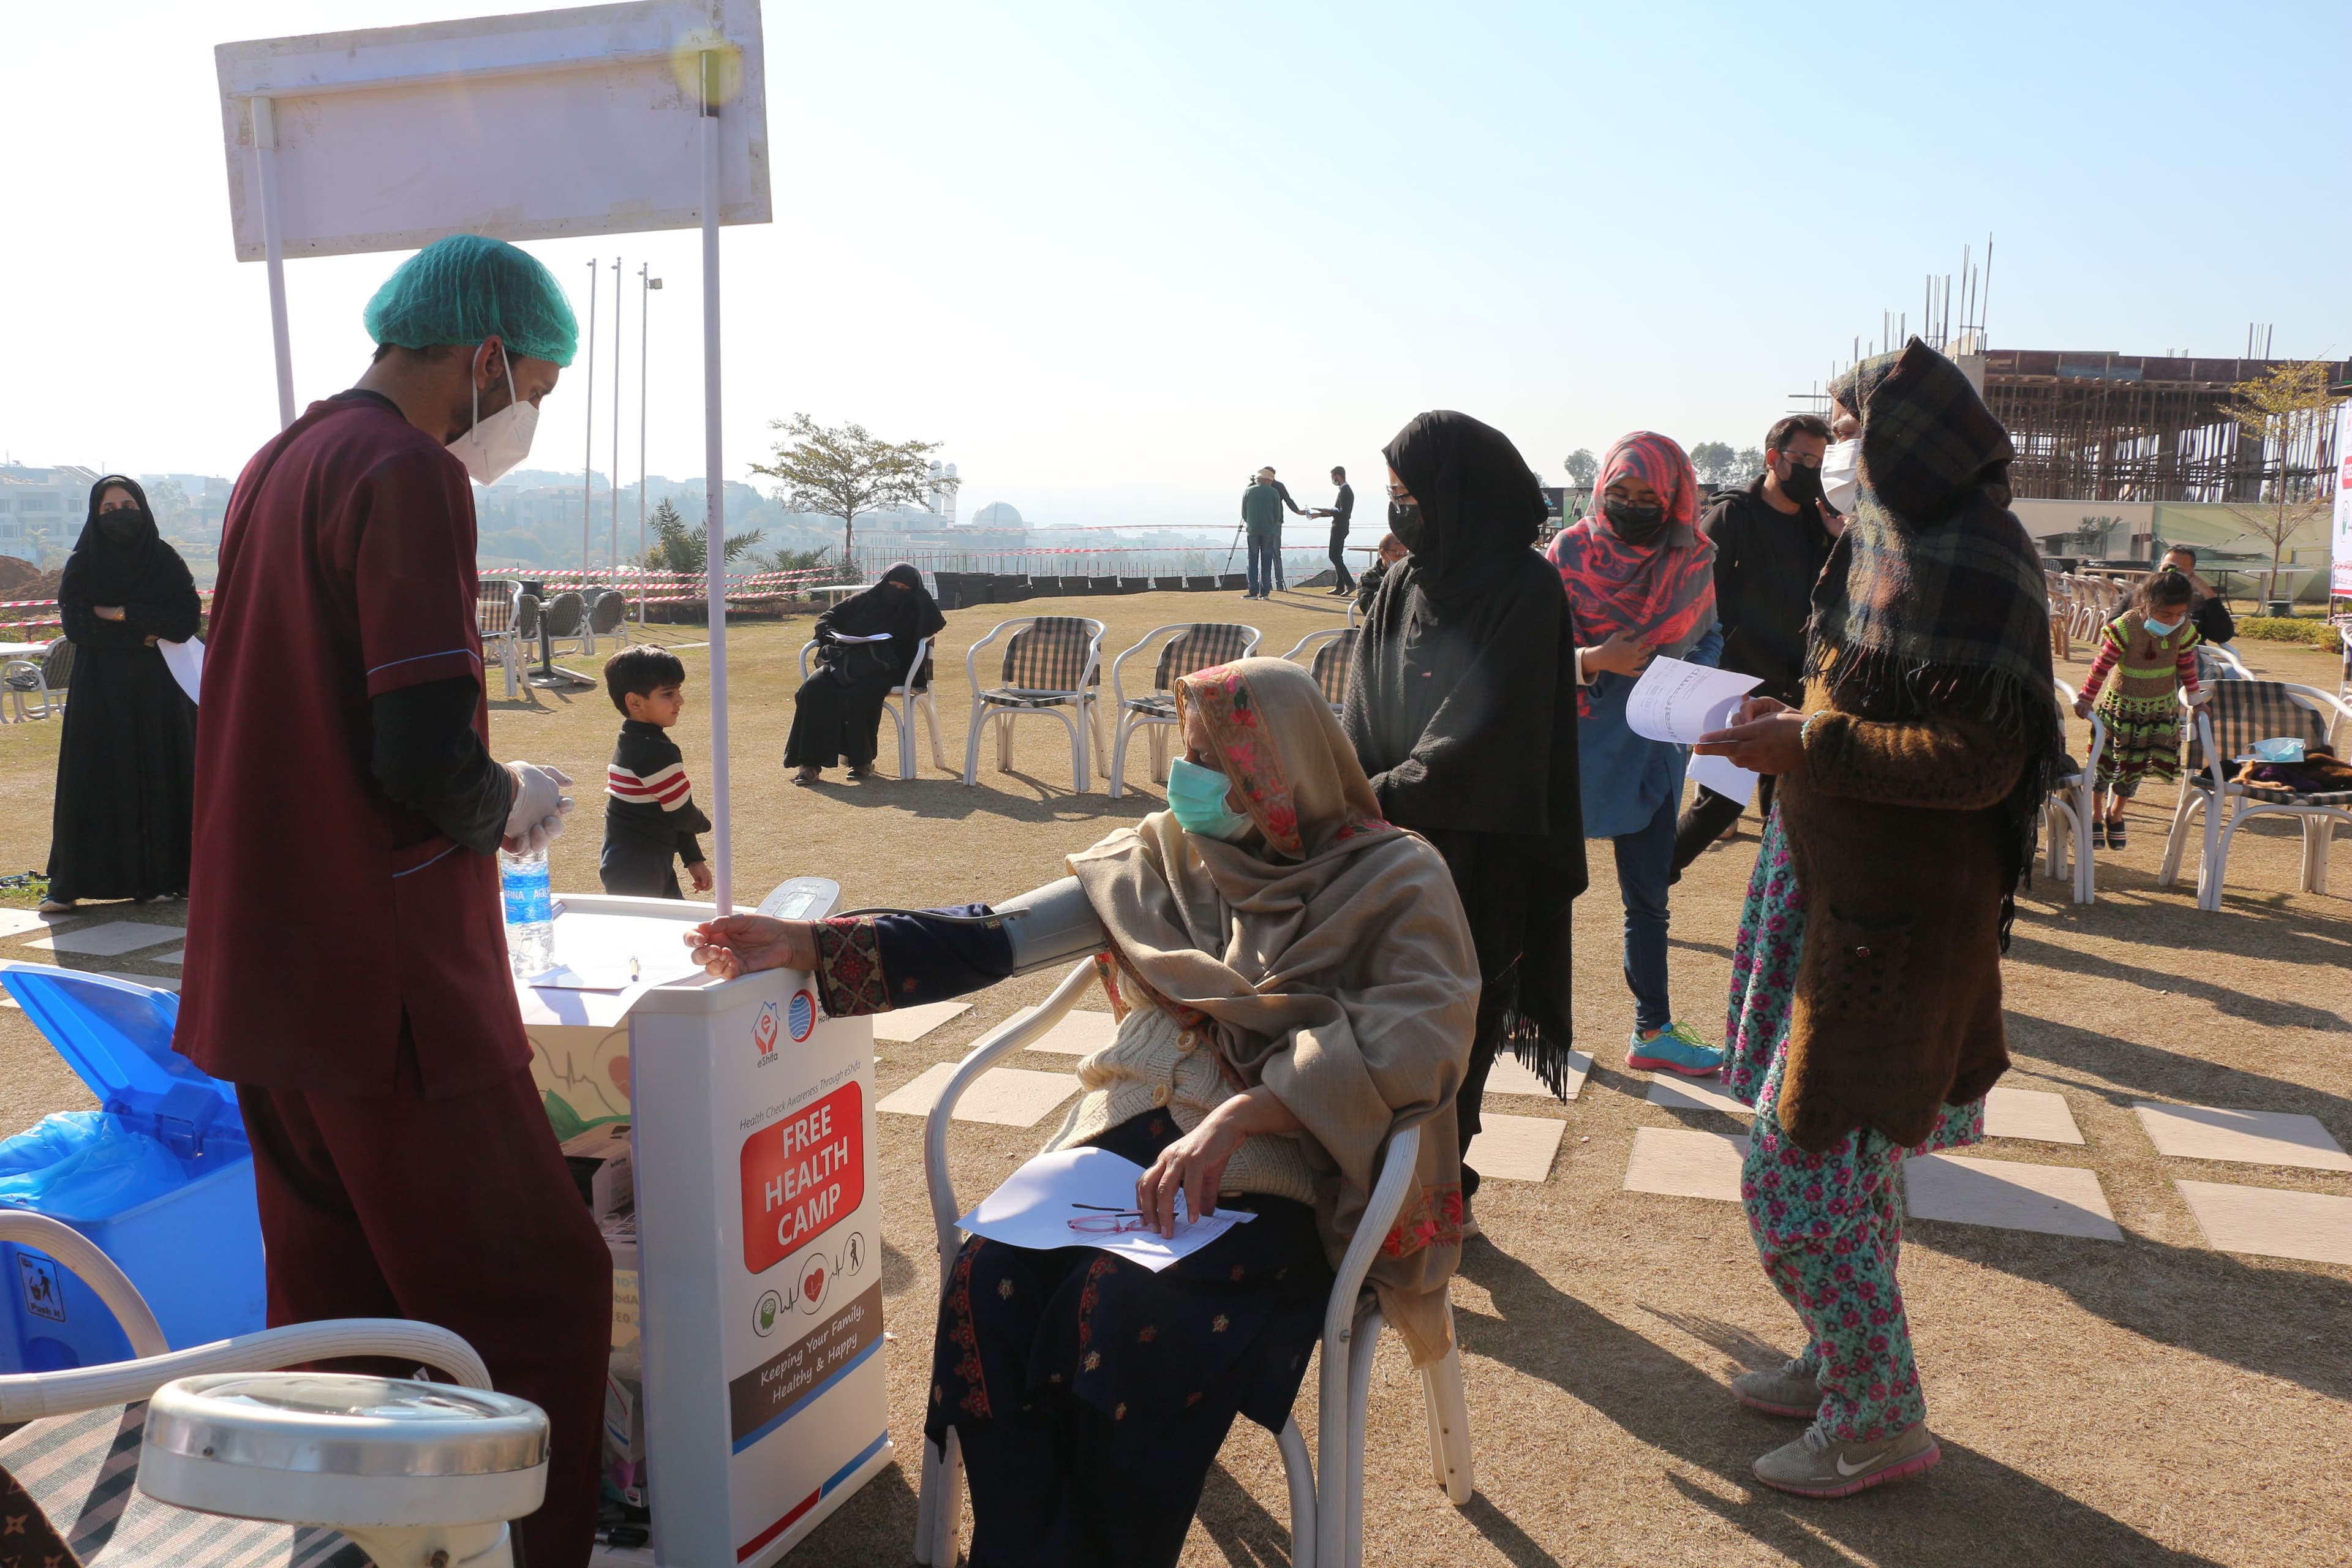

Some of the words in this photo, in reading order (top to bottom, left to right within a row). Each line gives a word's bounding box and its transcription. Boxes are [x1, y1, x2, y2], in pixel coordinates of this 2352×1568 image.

[740, 1111, 764, 1131] Health
[766, 1102, 786, 1119] Check
[786, 1085, 818, 1109] Awareness
[820, 1068, 843, 1090] Through
[844, 1060, 861, 1077] eShifa
[757, 1053, 778, 1068] eShifa
[783, 1104, 832, 1159] FREE
[765, 1136, 848, 1213] HEALTH
[777, 1183, 841, 1246] CAMP
[761, 1349, 804, 1387] Keeping
[806, 1329, 829, 1354] Your
[832, 1305, 865, 1336] Family,
[772, 1366, 813, 1404] Healthy
[816, 1357, 824, 1372] &
[828, 1333, 858, 1363] Happy
